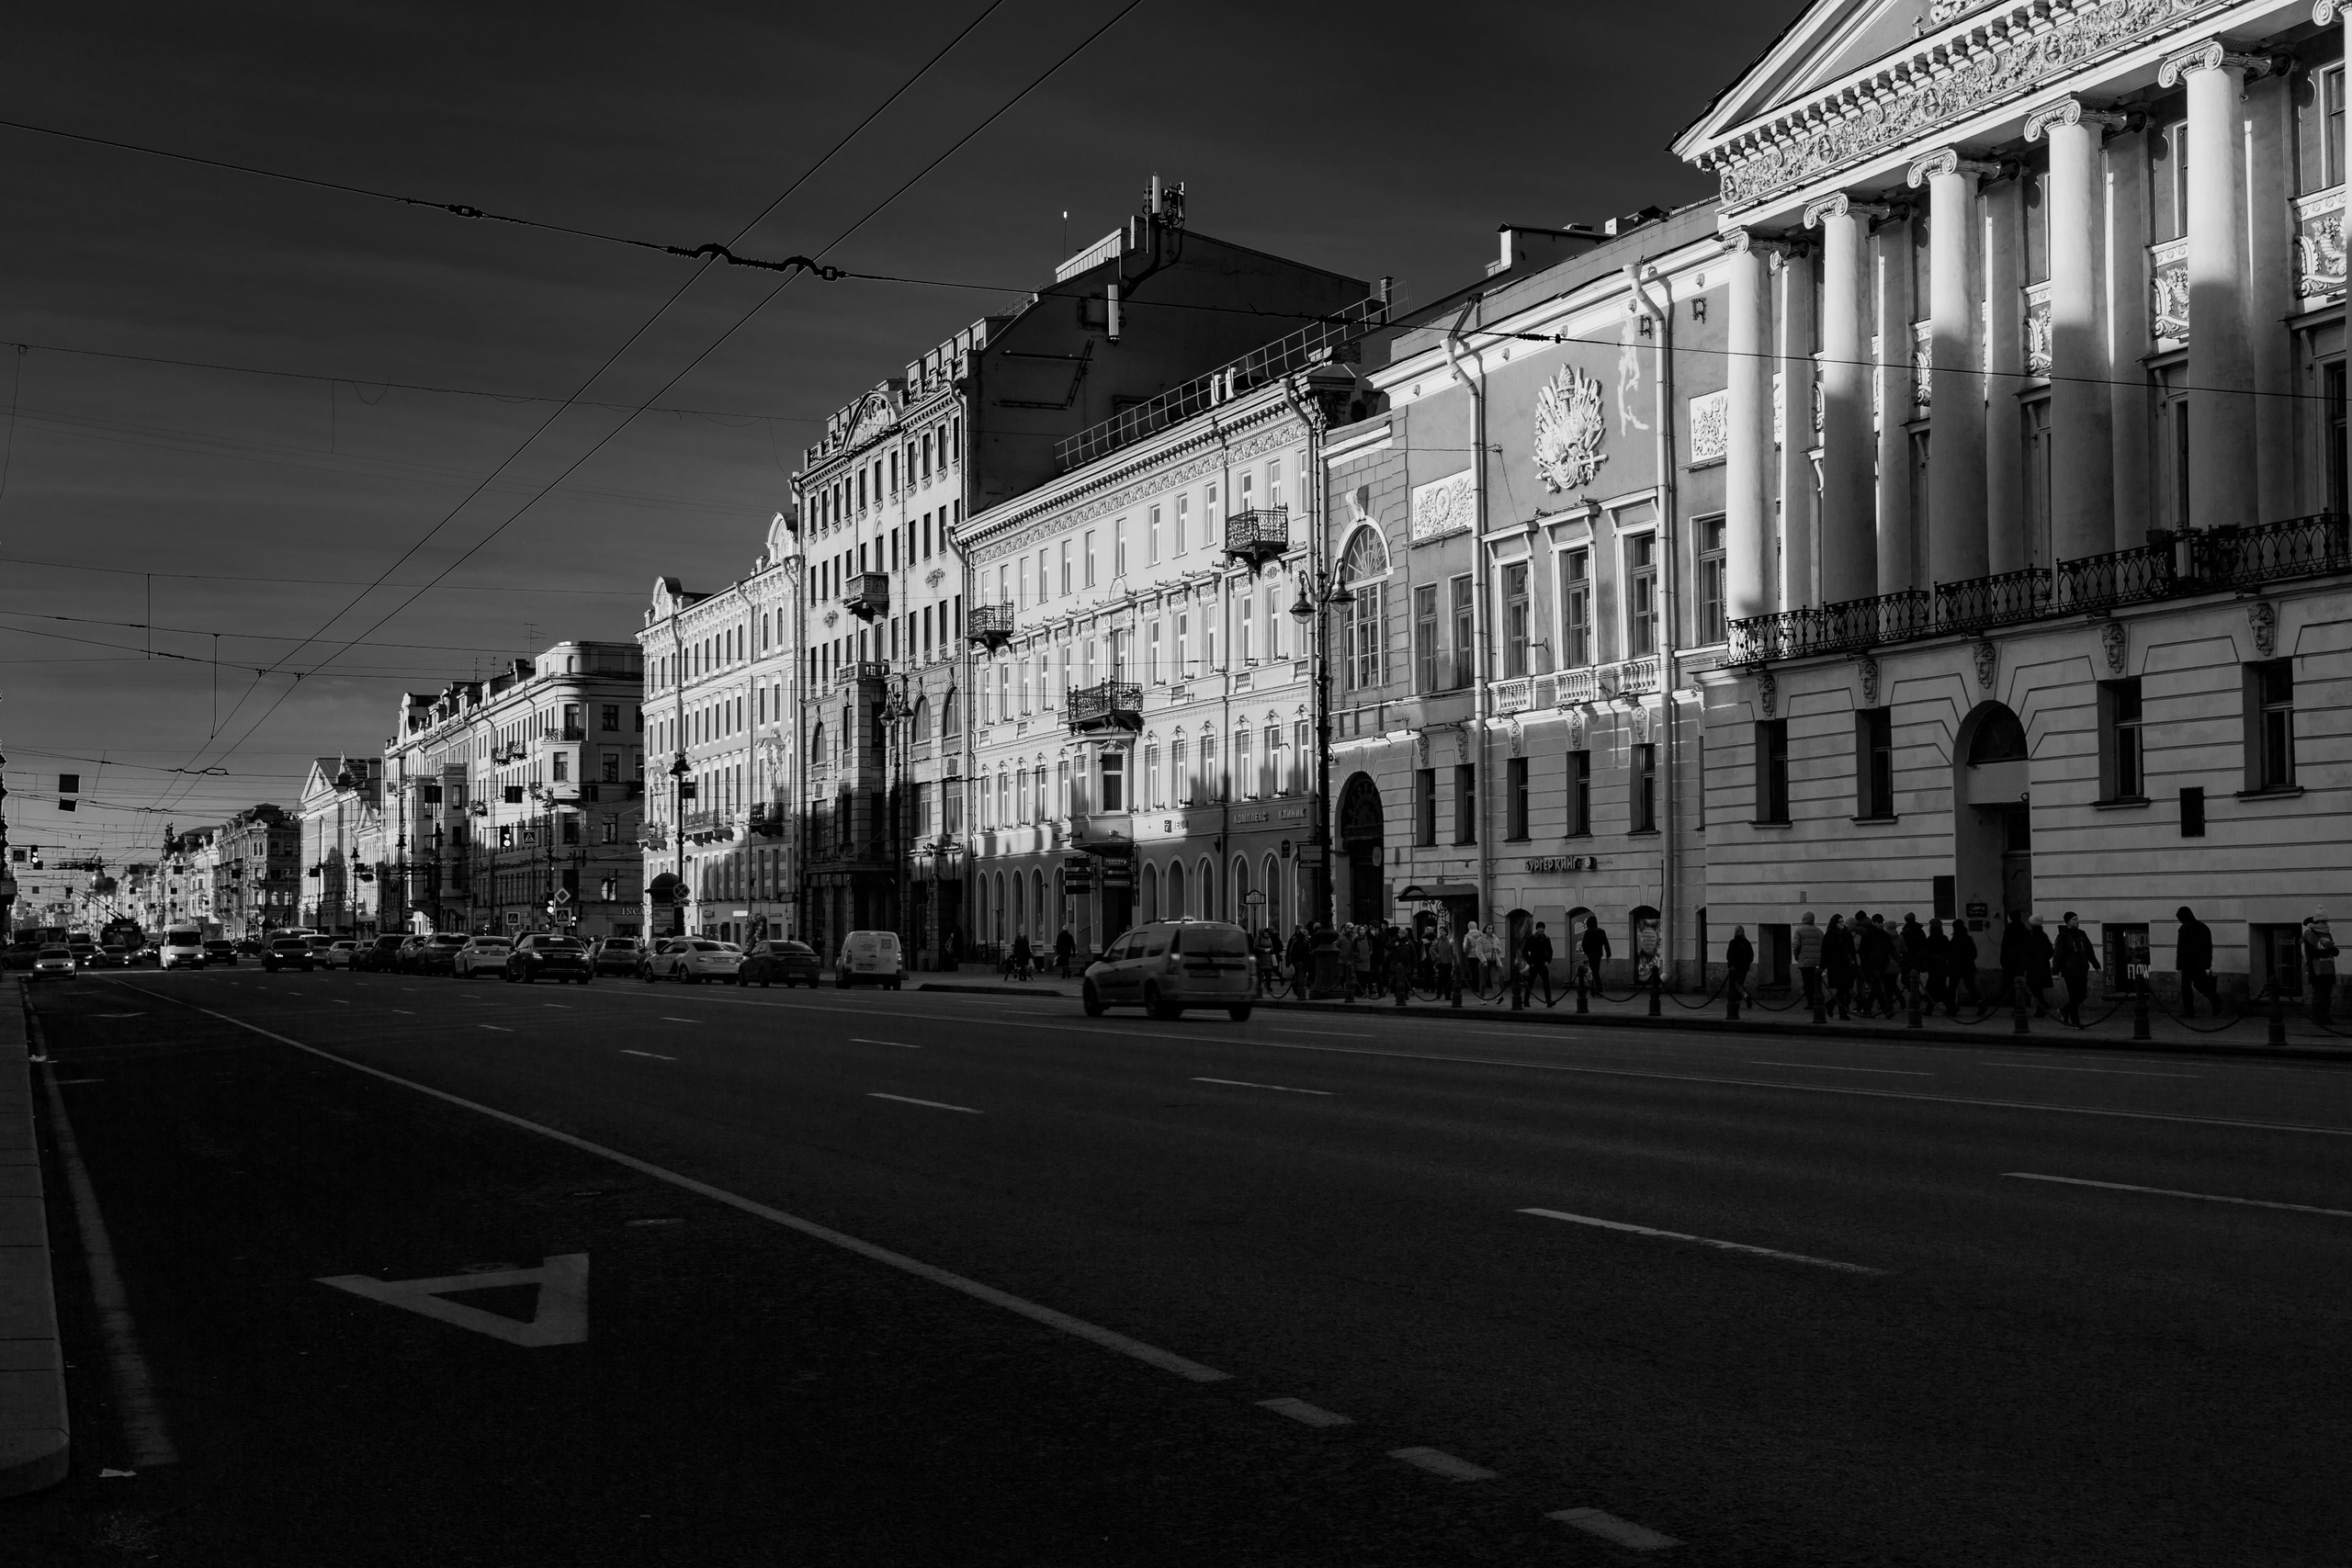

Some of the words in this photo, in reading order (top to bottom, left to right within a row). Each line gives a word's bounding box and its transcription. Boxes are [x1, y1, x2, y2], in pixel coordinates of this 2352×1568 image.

[1233, 811, 1268, 824] КОМПЛЕКС
[1278, 807, 1306, 820] КЛИНИК
[1525, 859, 1553, 871] БУРГЕР
[1555, 857, 1578, 870] КИНГ
[2106, 931, 2116, 987] ЦВЕТЫ
